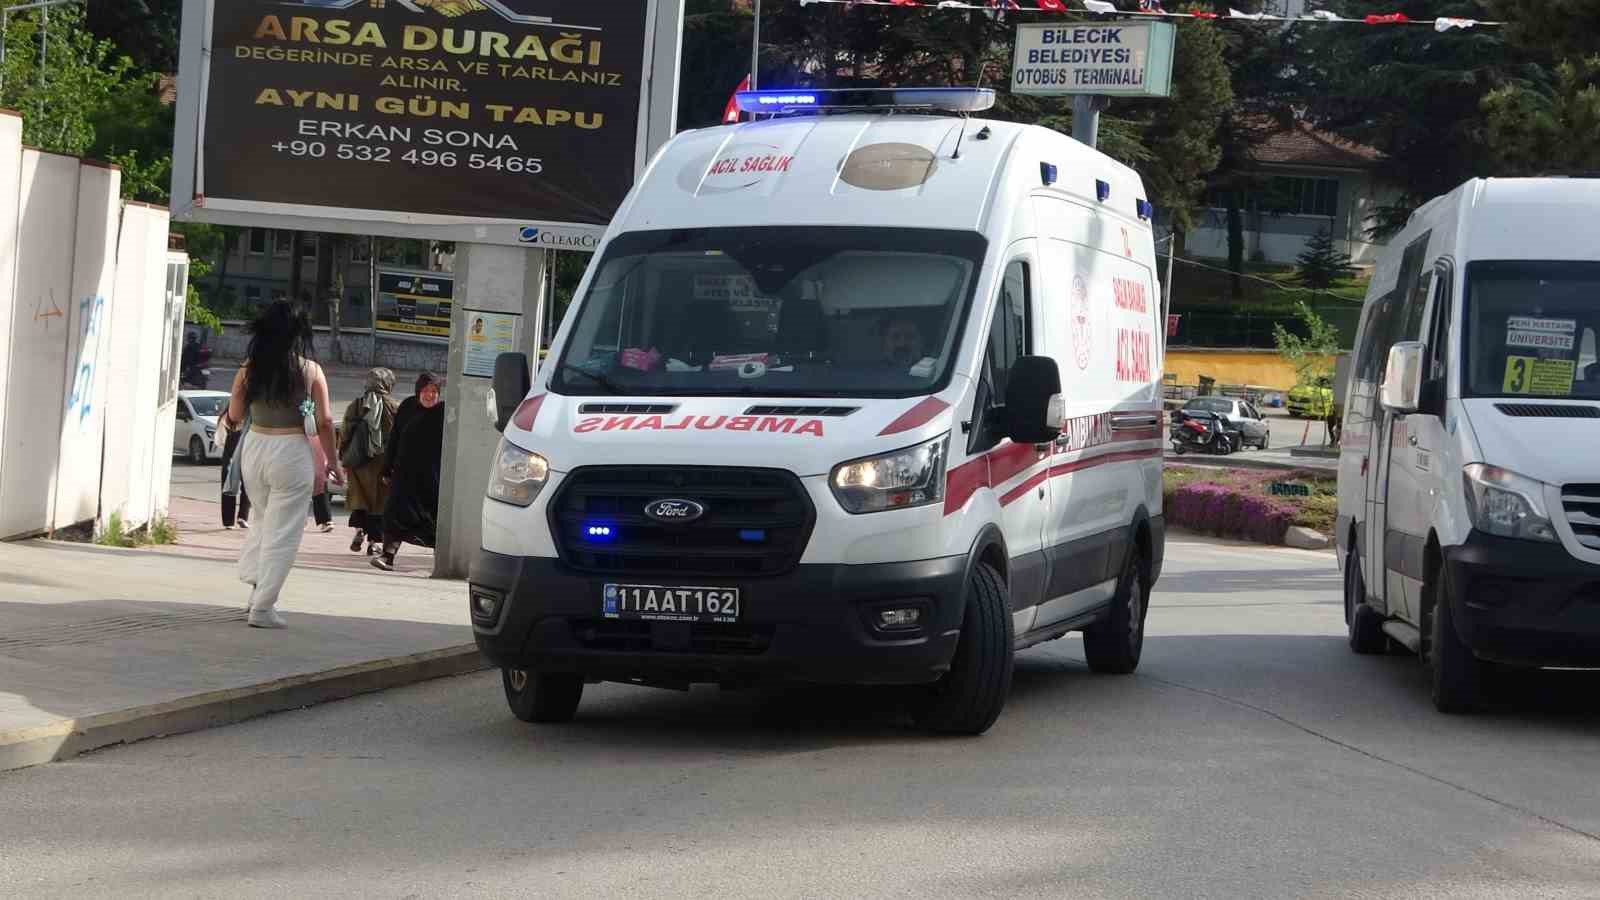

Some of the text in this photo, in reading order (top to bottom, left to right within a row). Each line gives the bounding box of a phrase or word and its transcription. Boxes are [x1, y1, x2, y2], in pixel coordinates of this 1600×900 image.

[254, 15, 602, 66] ARSA DURAĞI
[235, 45, 623, 86] DEĞERİNDE ARSA VE TARLANIZ
[1016, 67, 1067, 84] OTOBÜS
[380, 74, 468, 92] ALINIR.
[255, 88, 604, 129] AYNI GÜN TAPU
[298, 119, 518, 151] ERKAN SONA
[271, 140, 543, 174] +90 532 496 5465
[1511, 358, 1525, 393] 3
[656, 501, 689, 517] Ford
